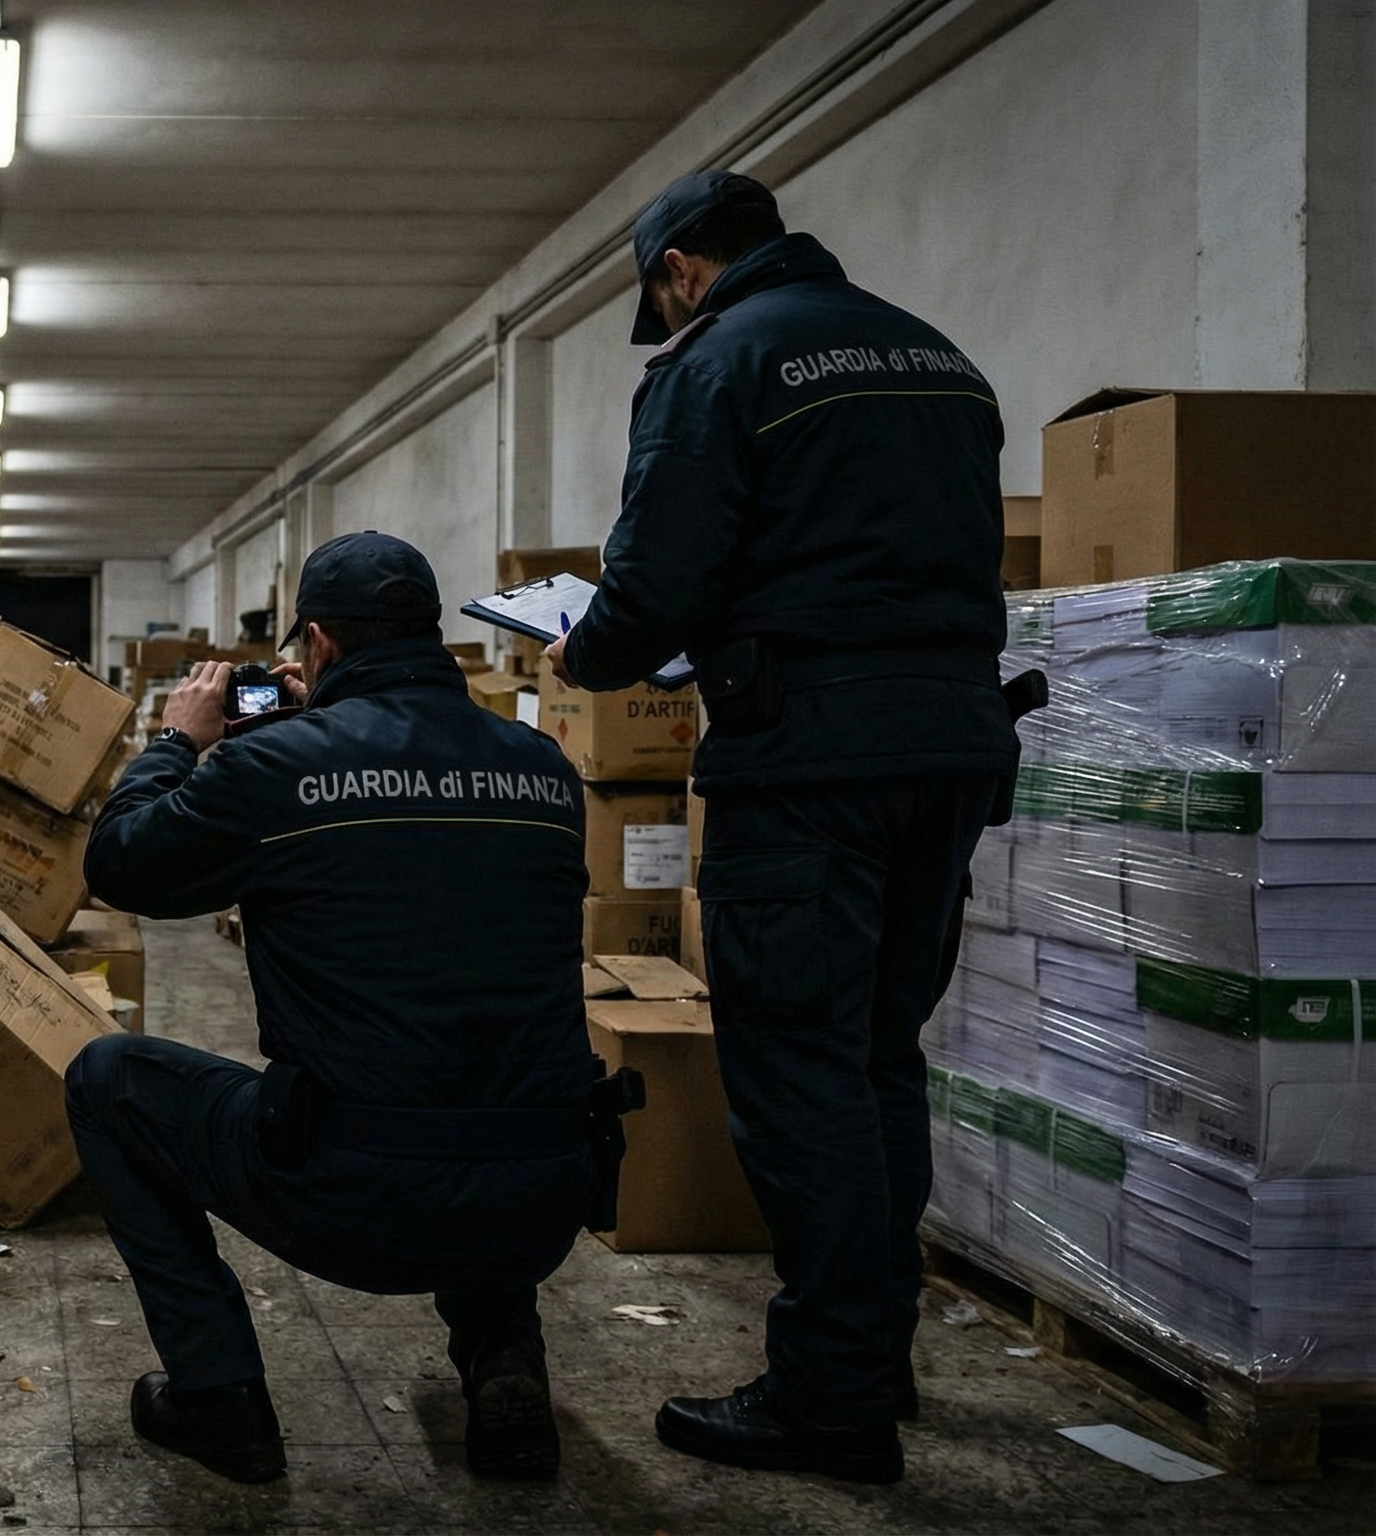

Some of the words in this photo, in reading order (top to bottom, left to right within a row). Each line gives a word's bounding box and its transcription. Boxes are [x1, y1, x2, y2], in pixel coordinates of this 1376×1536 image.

[780, 347, 885, 387] GUARDIA
[889, 348, 909, 372] di
[298, 769, 433, 805] GUARDIA
[439, 770, 464, 798] di
[471, 771, 575, 811] FINANZA
